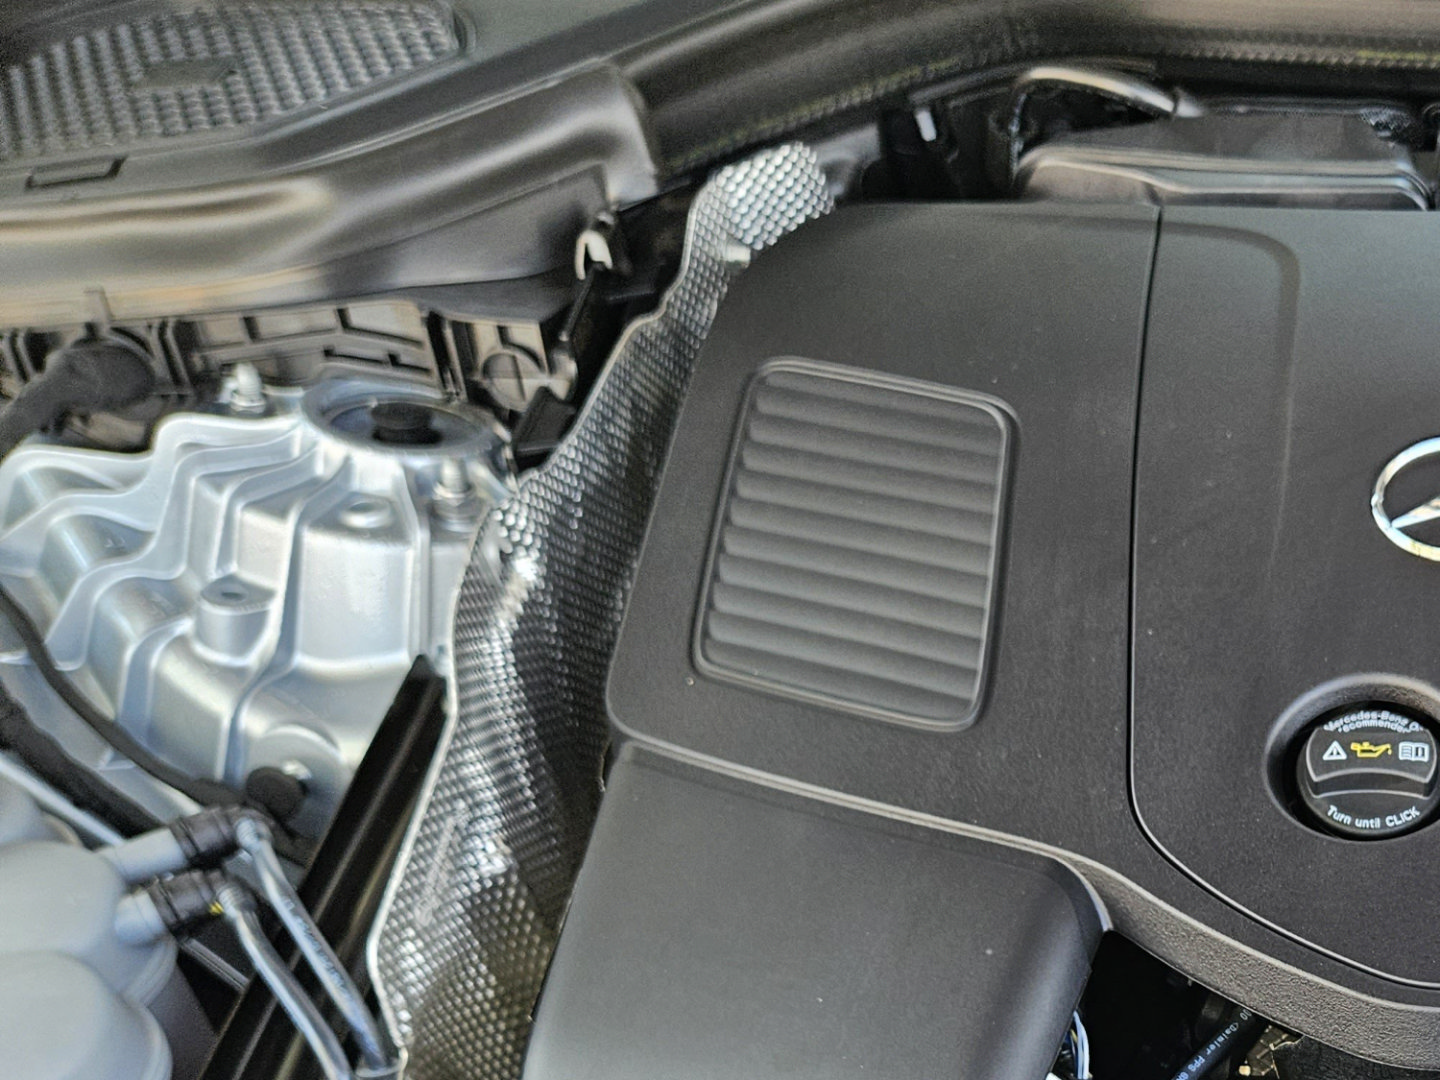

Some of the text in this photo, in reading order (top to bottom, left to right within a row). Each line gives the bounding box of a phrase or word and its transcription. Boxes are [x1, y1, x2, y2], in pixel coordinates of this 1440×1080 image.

[1323, 710, 1409, 732] Mercedes-Benz
[1327, 805, 1421, 829] Turn until CLICK
